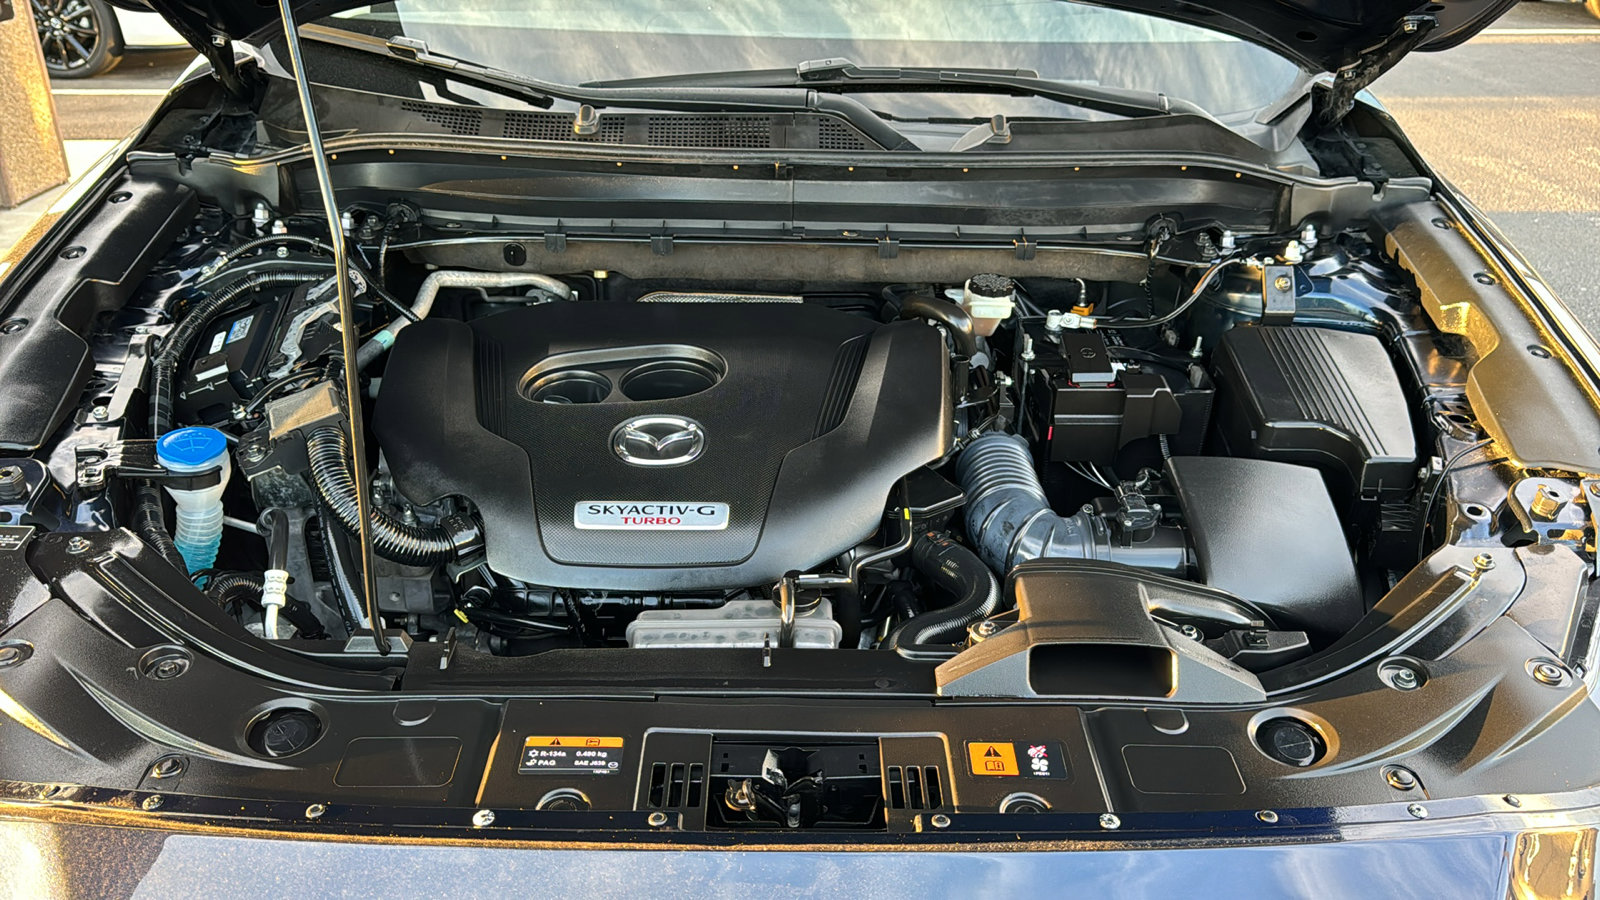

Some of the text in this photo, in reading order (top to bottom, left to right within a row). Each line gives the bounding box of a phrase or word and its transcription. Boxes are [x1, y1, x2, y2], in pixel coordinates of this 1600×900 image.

[587, 504, 716, 516] SKYACTIV-G
[621, 516, 681, 525] TURBO
[597, 750, 608, 758] kg
